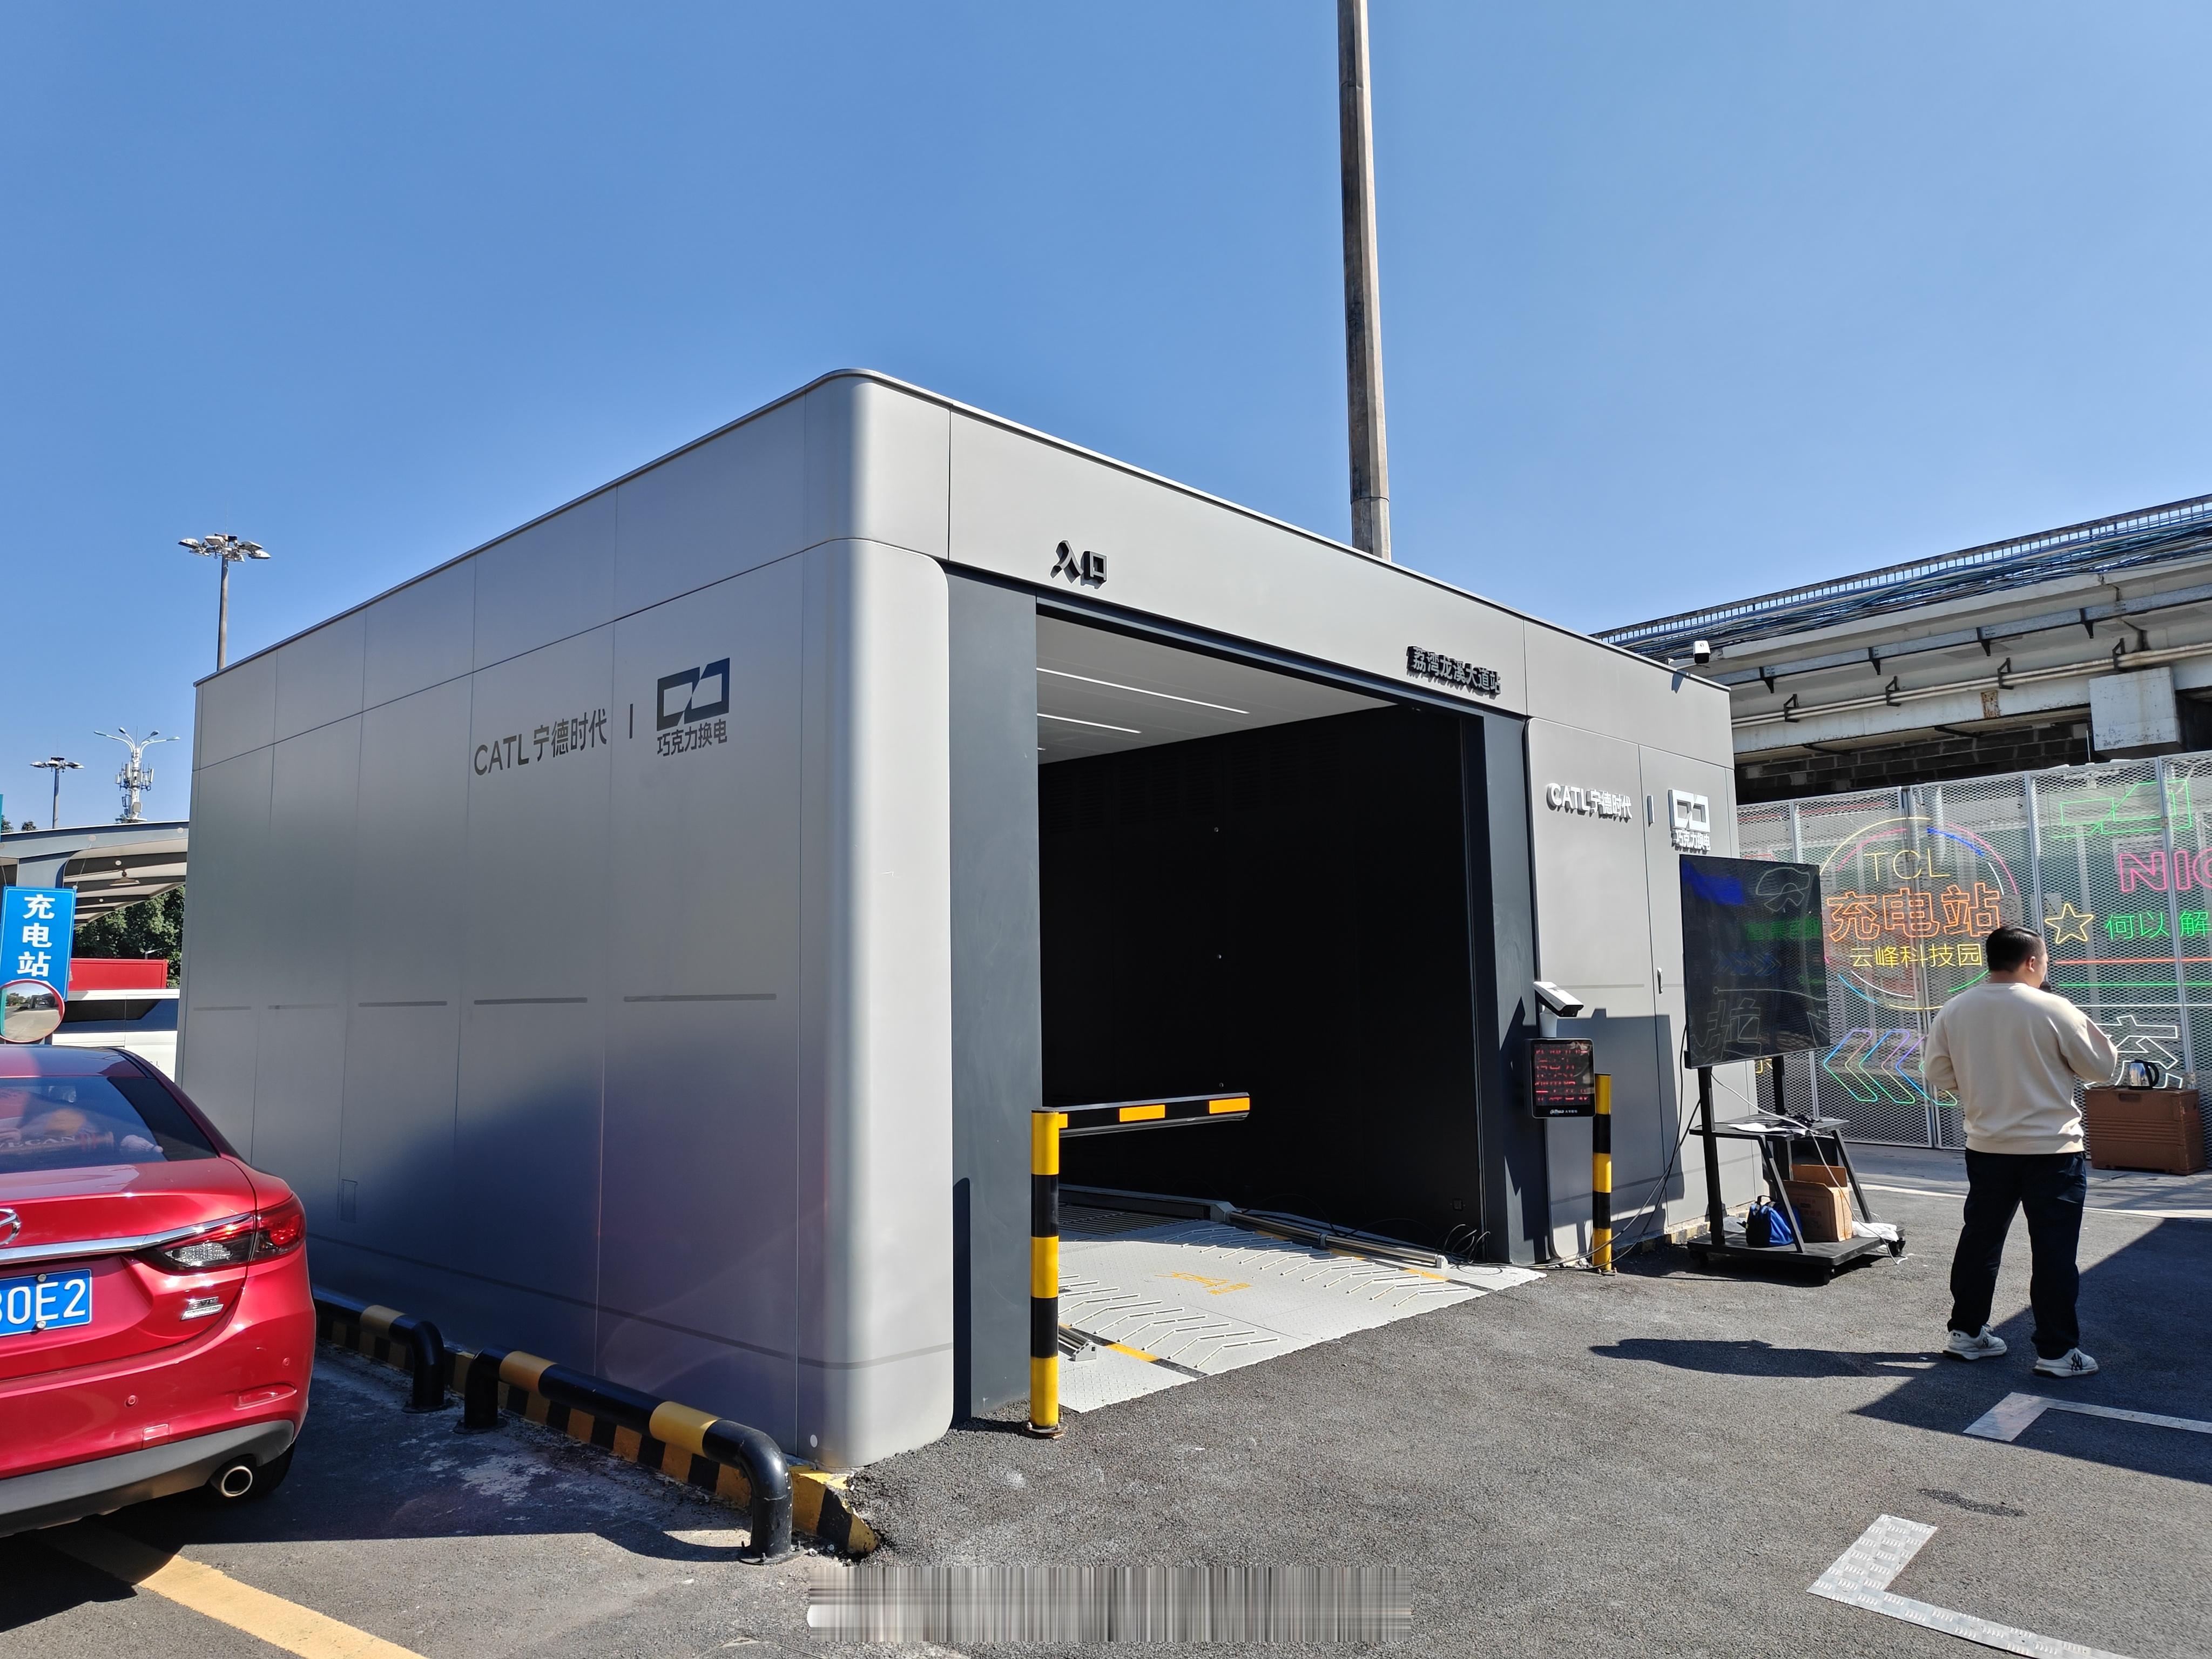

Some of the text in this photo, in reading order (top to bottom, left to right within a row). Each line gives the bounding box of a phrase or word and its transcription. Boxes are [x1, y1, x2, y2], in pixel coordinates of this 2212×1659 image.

[1050, 540, 1107, 589] 入口
[1407, 646, 1501, 699] 荔湾龙溪大道站
[474, 709, 607, 775] CATL 宁德时代
[657, 719, 727, 757] 巧克力换电
[1547, 783, 1633, 822] CATL 宁德时代
[1671, 829, 1711, 854] 巧克力换电
[1864, 848, 1951, 882] TCL
[1826, 882, 2001, 942] 充电站
[17, 894, 56, 977] 充电站
[1849, 942, 1982, 968] 云峰科技园
[0, 1279, 86, 1324] 0E2
